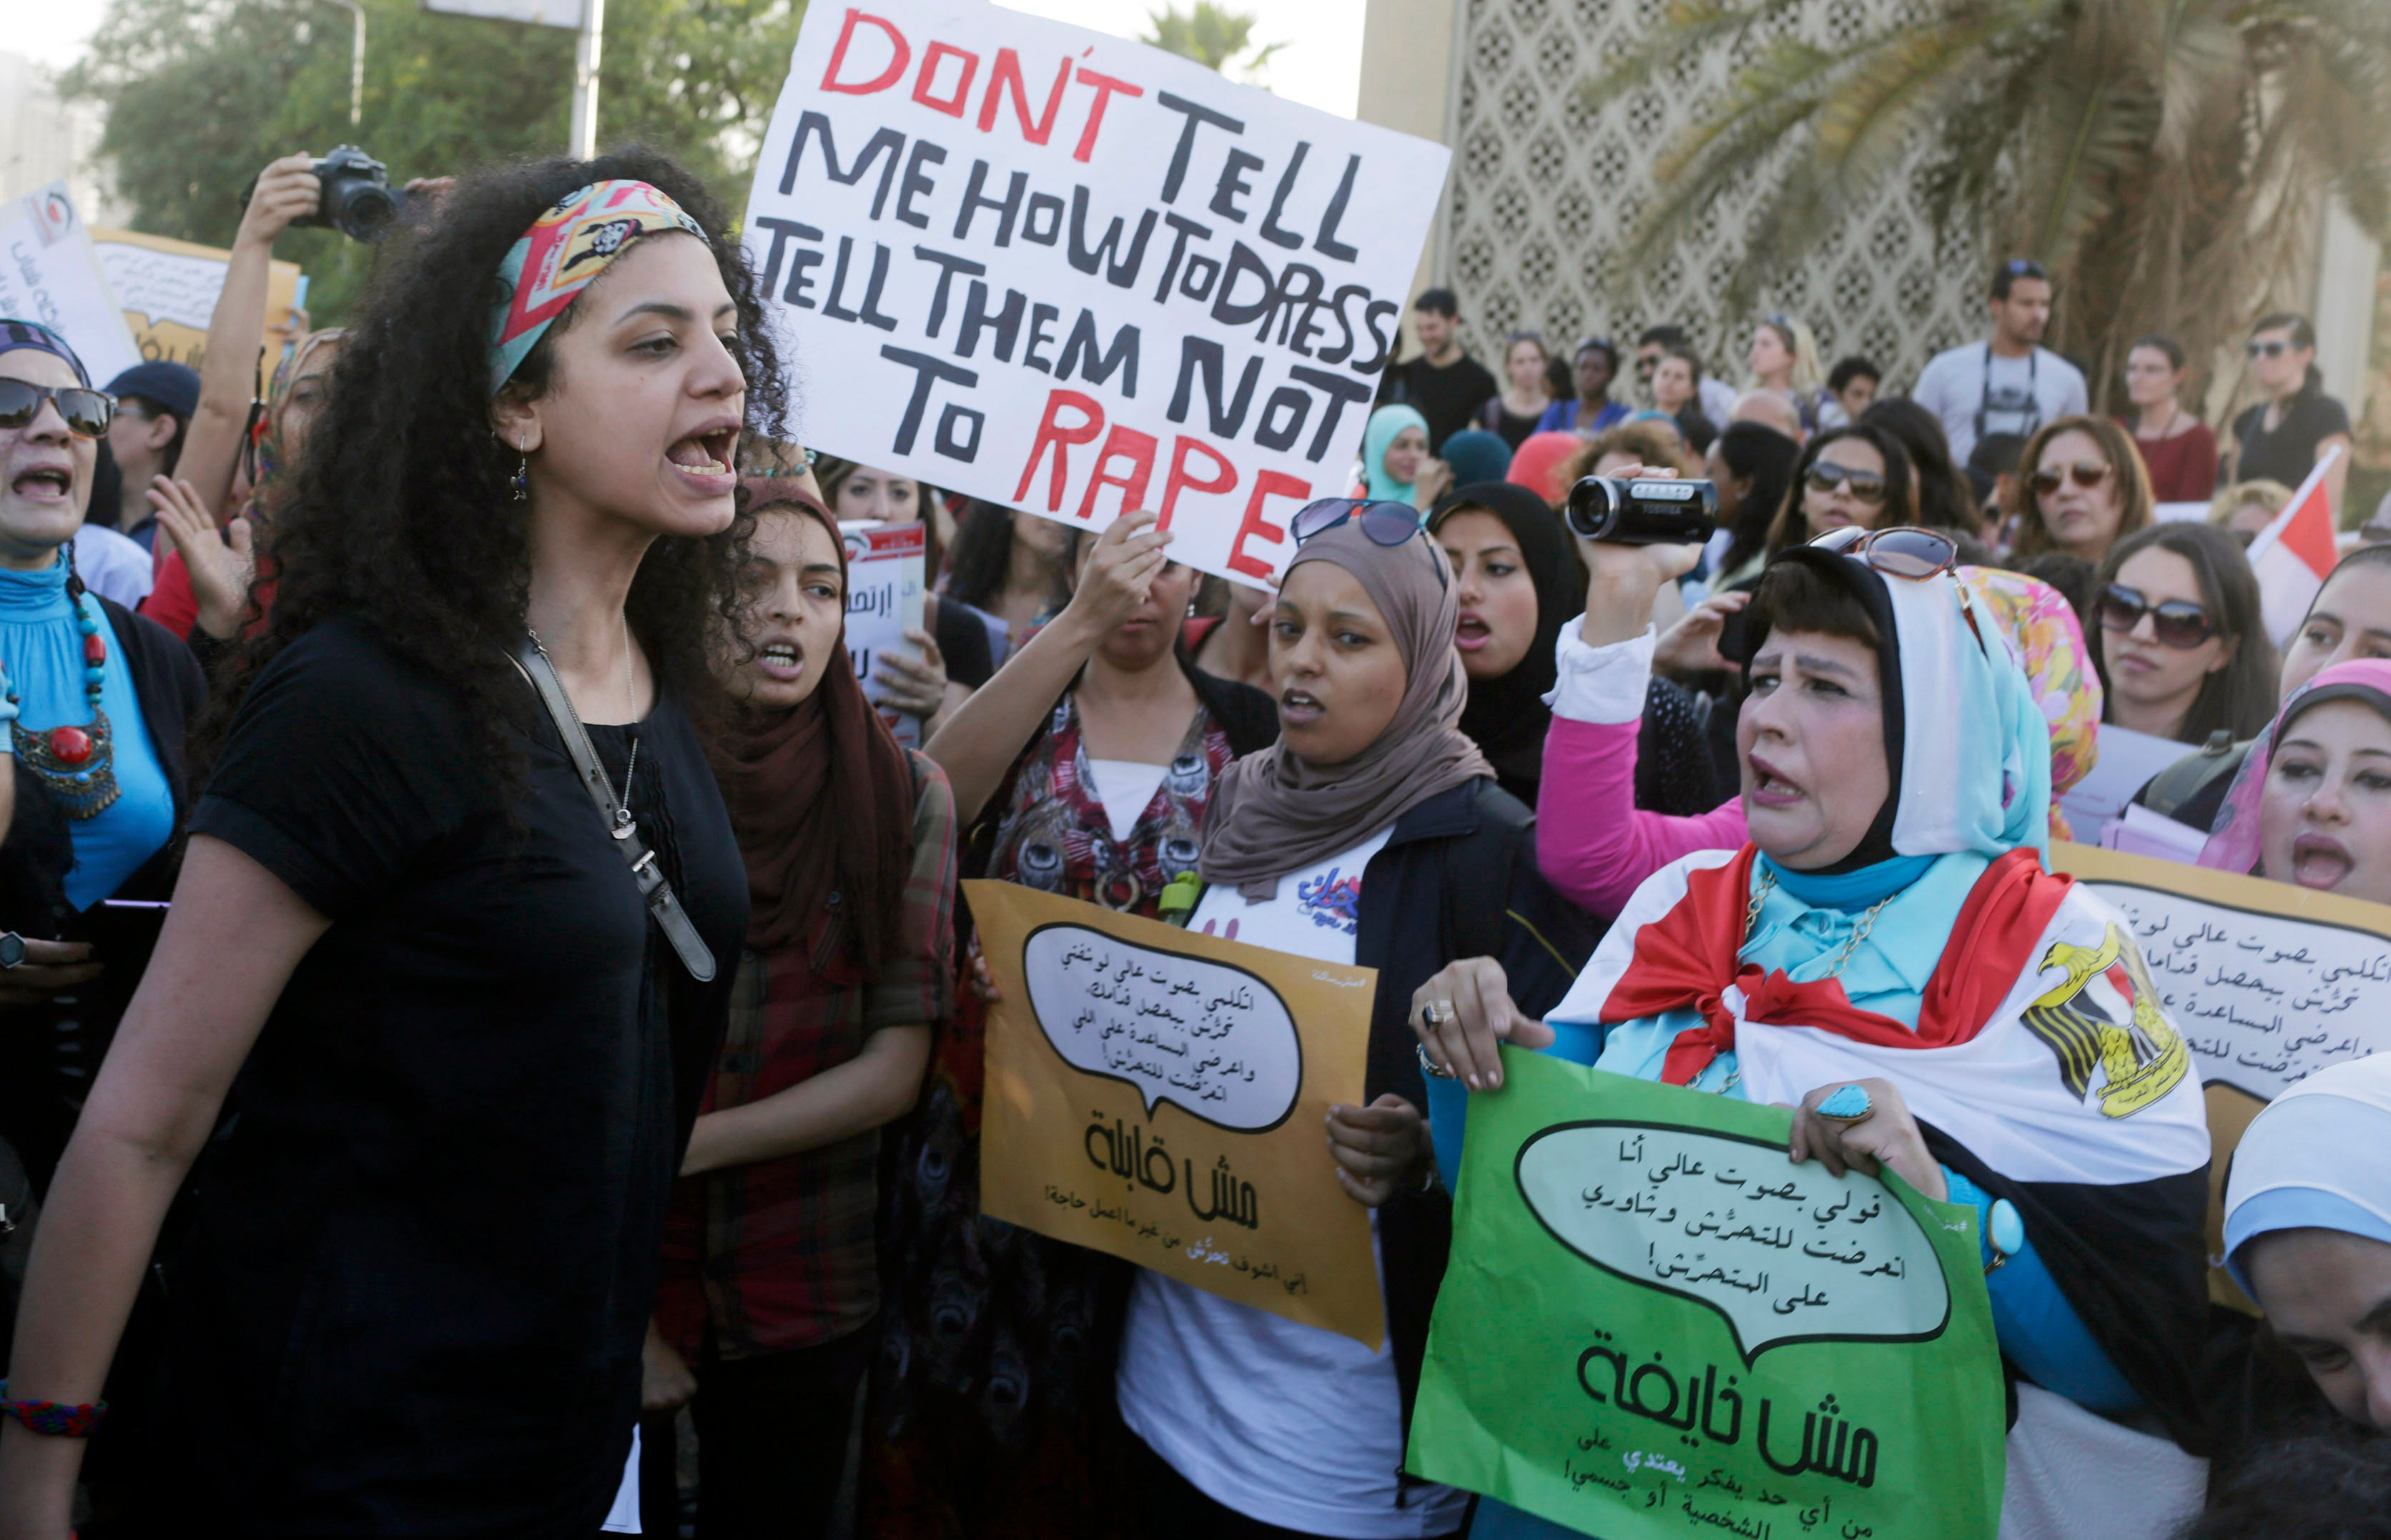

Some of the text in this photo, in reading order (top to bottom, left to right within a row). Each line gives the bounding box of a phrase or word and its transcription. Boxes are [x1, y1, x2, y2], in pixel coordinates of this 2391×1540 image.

[820, 8, 1361, 262] DON'T TELL
[779, 110, 1399, 375] ME HOW TO DRESS
[755, 216, 1371, 464] TELL THEM NOT
[880, 345, 1313, 581] TO RAPE
[2140, 914, 2170, 937] لو
[2173, 922, 2228, 956] عالي
[1061, 943, 1093, 971] شفتي
[1094, 952, 1109, 972] لو
[2237, 935, 2317, 974] بصوت
[1113, 958, 1144, 989] عالي
[1149, 970, 1201, 1005] بصوت
[2204, 966, 2285, 1005] بيحصل
[1072, 1007, 1096, 1035] اللي
[1099, 1017, 1125, 1041] على
[1136, 998, 1185, 1032] بيحصل
[2184, 992, 2284, 1035] المساعدة
[1130, 1021, 1190, 1058] المساعدة
[1618, 1134, 1646, 1164] أنا
[1084, 1110, 1259, 1230] مش قابلة
[1647, 1151, 1706, 1190] عالي
[1581, 1184, 1678, 1223] وشاوري
[1714, 1168, 1808, 1213] بصوت
[1124, 1208, 1136, 1228] ما
[1813, 1189, 1881, 1230] قولي
[1137, 1220, 1159, 1239] غير
[1162, 1230, 1180, 1249] من
[1772, 1283, 1830, 1315] على
[1576, 1328, 1879, 1489] مش خايفة
[1563, 1458, 1632, 1500] جسمي!
[1577, 1427, 1873, 1540] من أي حد يفكر يعتدي على
[1645, 1479, 1668, 1509] أو
